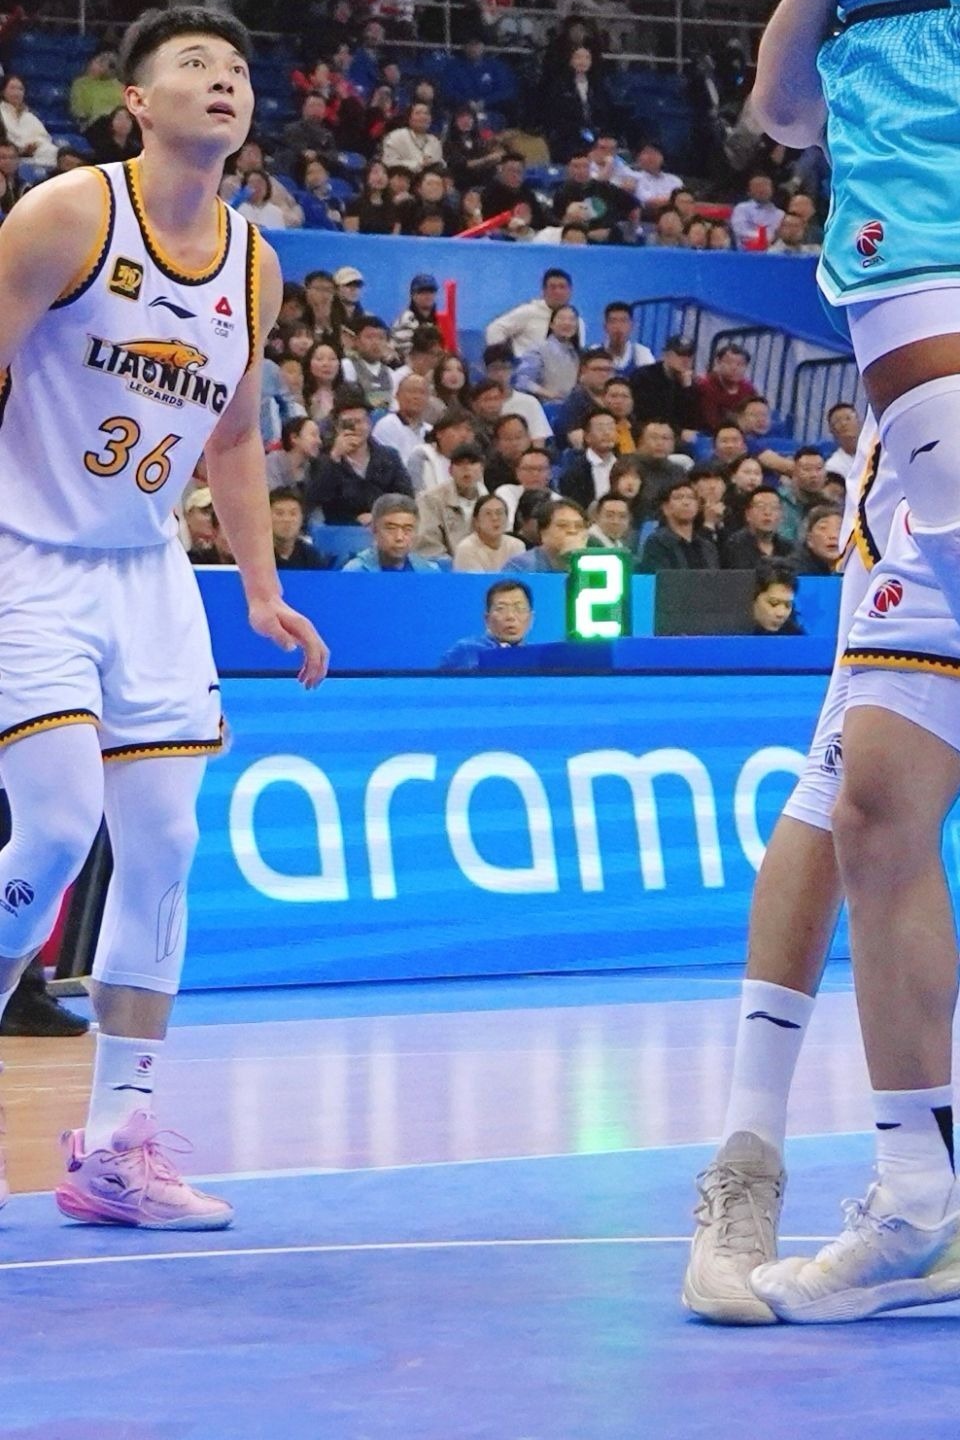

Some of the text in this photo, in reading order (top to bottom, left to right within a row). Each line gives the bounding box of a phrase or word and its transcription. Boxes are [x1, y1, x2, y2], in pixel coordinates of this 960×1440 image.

[84, 334, 230, 417] LIAONING
[128, 381, 184, 409] LEOPARDS
[84, 415, 183, 494] 36
[575, 554, 624, 639] 2
